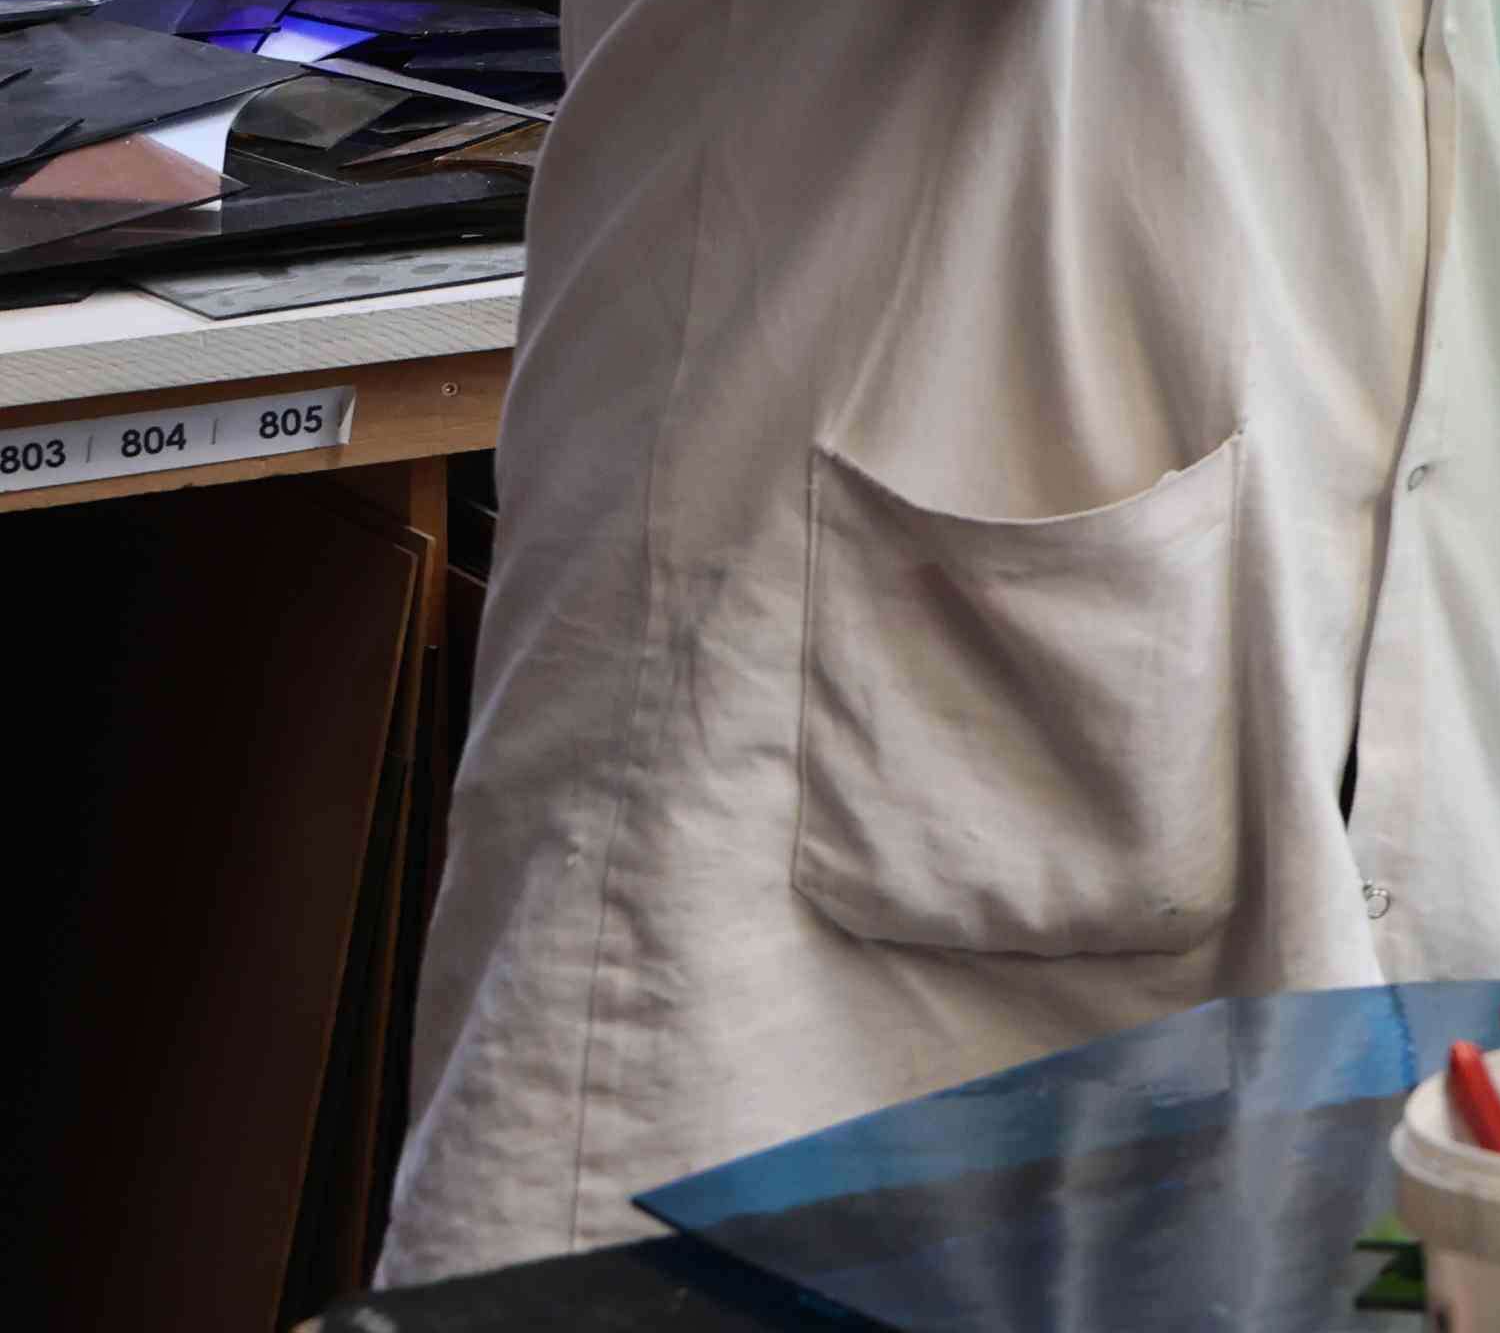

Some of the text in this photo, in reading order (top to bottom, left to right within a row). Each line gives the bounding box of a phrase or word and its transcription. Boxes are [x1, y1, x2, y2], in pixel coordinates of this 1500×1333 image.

[0, 404, 323, 474] 803 804 805
